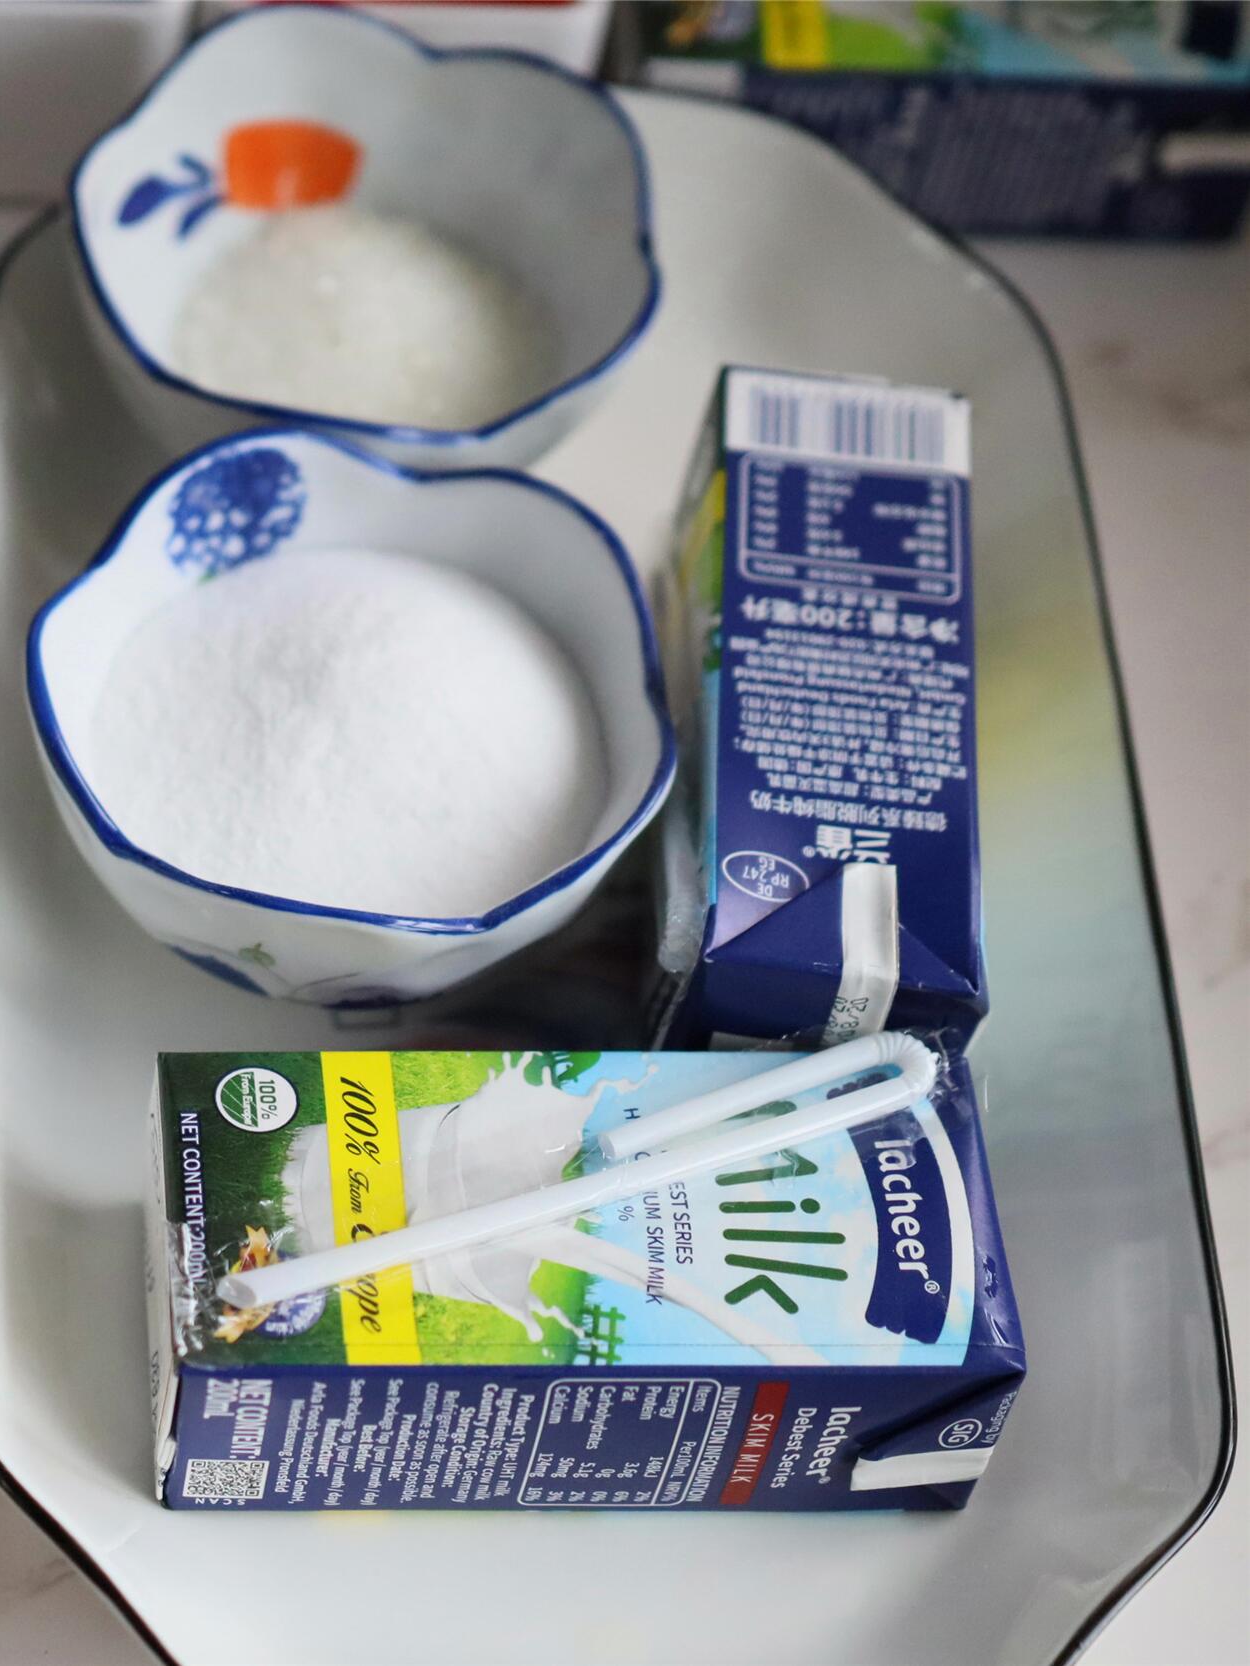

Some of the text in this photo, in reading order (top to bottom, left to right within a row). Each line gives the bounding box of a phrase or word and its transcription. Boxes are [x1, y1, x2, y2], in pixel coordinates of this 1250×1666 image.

[742, 865, 789, 888] RP 247
[759, 856, 775, 870] EG
[758, 884, 773, 897] DE
[241, 1074, 253, 1125] From Europe
[259, 1080, 278, 1119] 100%
[180, 1112, 200, 1144] NET
[340, 1076, 381, 1165] 100%
[347, 1168, 370, 1214] From
[873, 1138, 940, 1294] lacheer®
[646, 1226, 665, 1264] SKIM
[673, 1212, 694, 1264] SERIES
[645, 1266, 663, 1305] MILK
[349, 1378, 366, 1396] See
[388, 1378, 404, 1397] See
[571, 1385, 594, 1422] Sodium
[621, 1385, 639, 1402] Fat
[639, 1385, 662, 1420] Protein
[659, 1385, 684, 1418] Energy
[692, 1385, 712, 1412] Items
[229, 1379, 273, 1459] NET CONTENT:
[342, 1397, 363, 1429] Package
[379, 1397, 401, 1430] Package
[548, 1385, 571, 1424] Calcium
[585, 1385, 617, 1449] Carbohydrates
[275, 1399, 306, 1492] Niederlassung Pronsfeld
[288, 1381, 327, 1504] Arla Foods Deutschland GmbH,
[315, 1418, 342, 1477] Manufacturer:
[339, 1430, 357, 1443] Top
[353, 1424, 377, 1472] Best Before:
[378, 1431, 394, 1444] Top
[388, 1414, 417, 1481] Production Date:
[400, 1382, 439, 1503] consume as soon as possible.
[420, 1390, 460, 1498] Refrigerate after open and
[442, 1406, 476, 1487] Storage Condition:
[451, 1383, 499, 1503] Country of Origin: Germany
[474, 1388, 517, 1500] Ingredients: Raw cow milk
[493, 1394, 535, 1496] Product Type: UHT milk
[685, 1386, 740, 1501] NUTRITION INFORMATION
[730, 1413, 775, 1483] SKIM MILK
[770, 1407, 818, 1488] Debest Series
[948, 1424, 974, 1442] SIG
[981, 1433, 1000, 1444] by
[336, 1445, 354, 1463] (year
[373, 1446, 391, 1463] (year
[528, 1453, 554, 1478] 124mg
[550, 1457, 573, 1478] 50mg
[572, 1462, 595, 1478] 5.1g
[617, 1462, 640, 1478] 3.6g
[643, 1456, 664, 1477] 148kJ
[331, 1467, 349, 1488] month
[368, 1467, 386, 1488] month
[596, 1468, 615, 1478] 0g
[324, 1492, 344, 1505] day)
[360, 1492, 381, 1505] day)
[660, 1481, 683, 1501] NRV%
